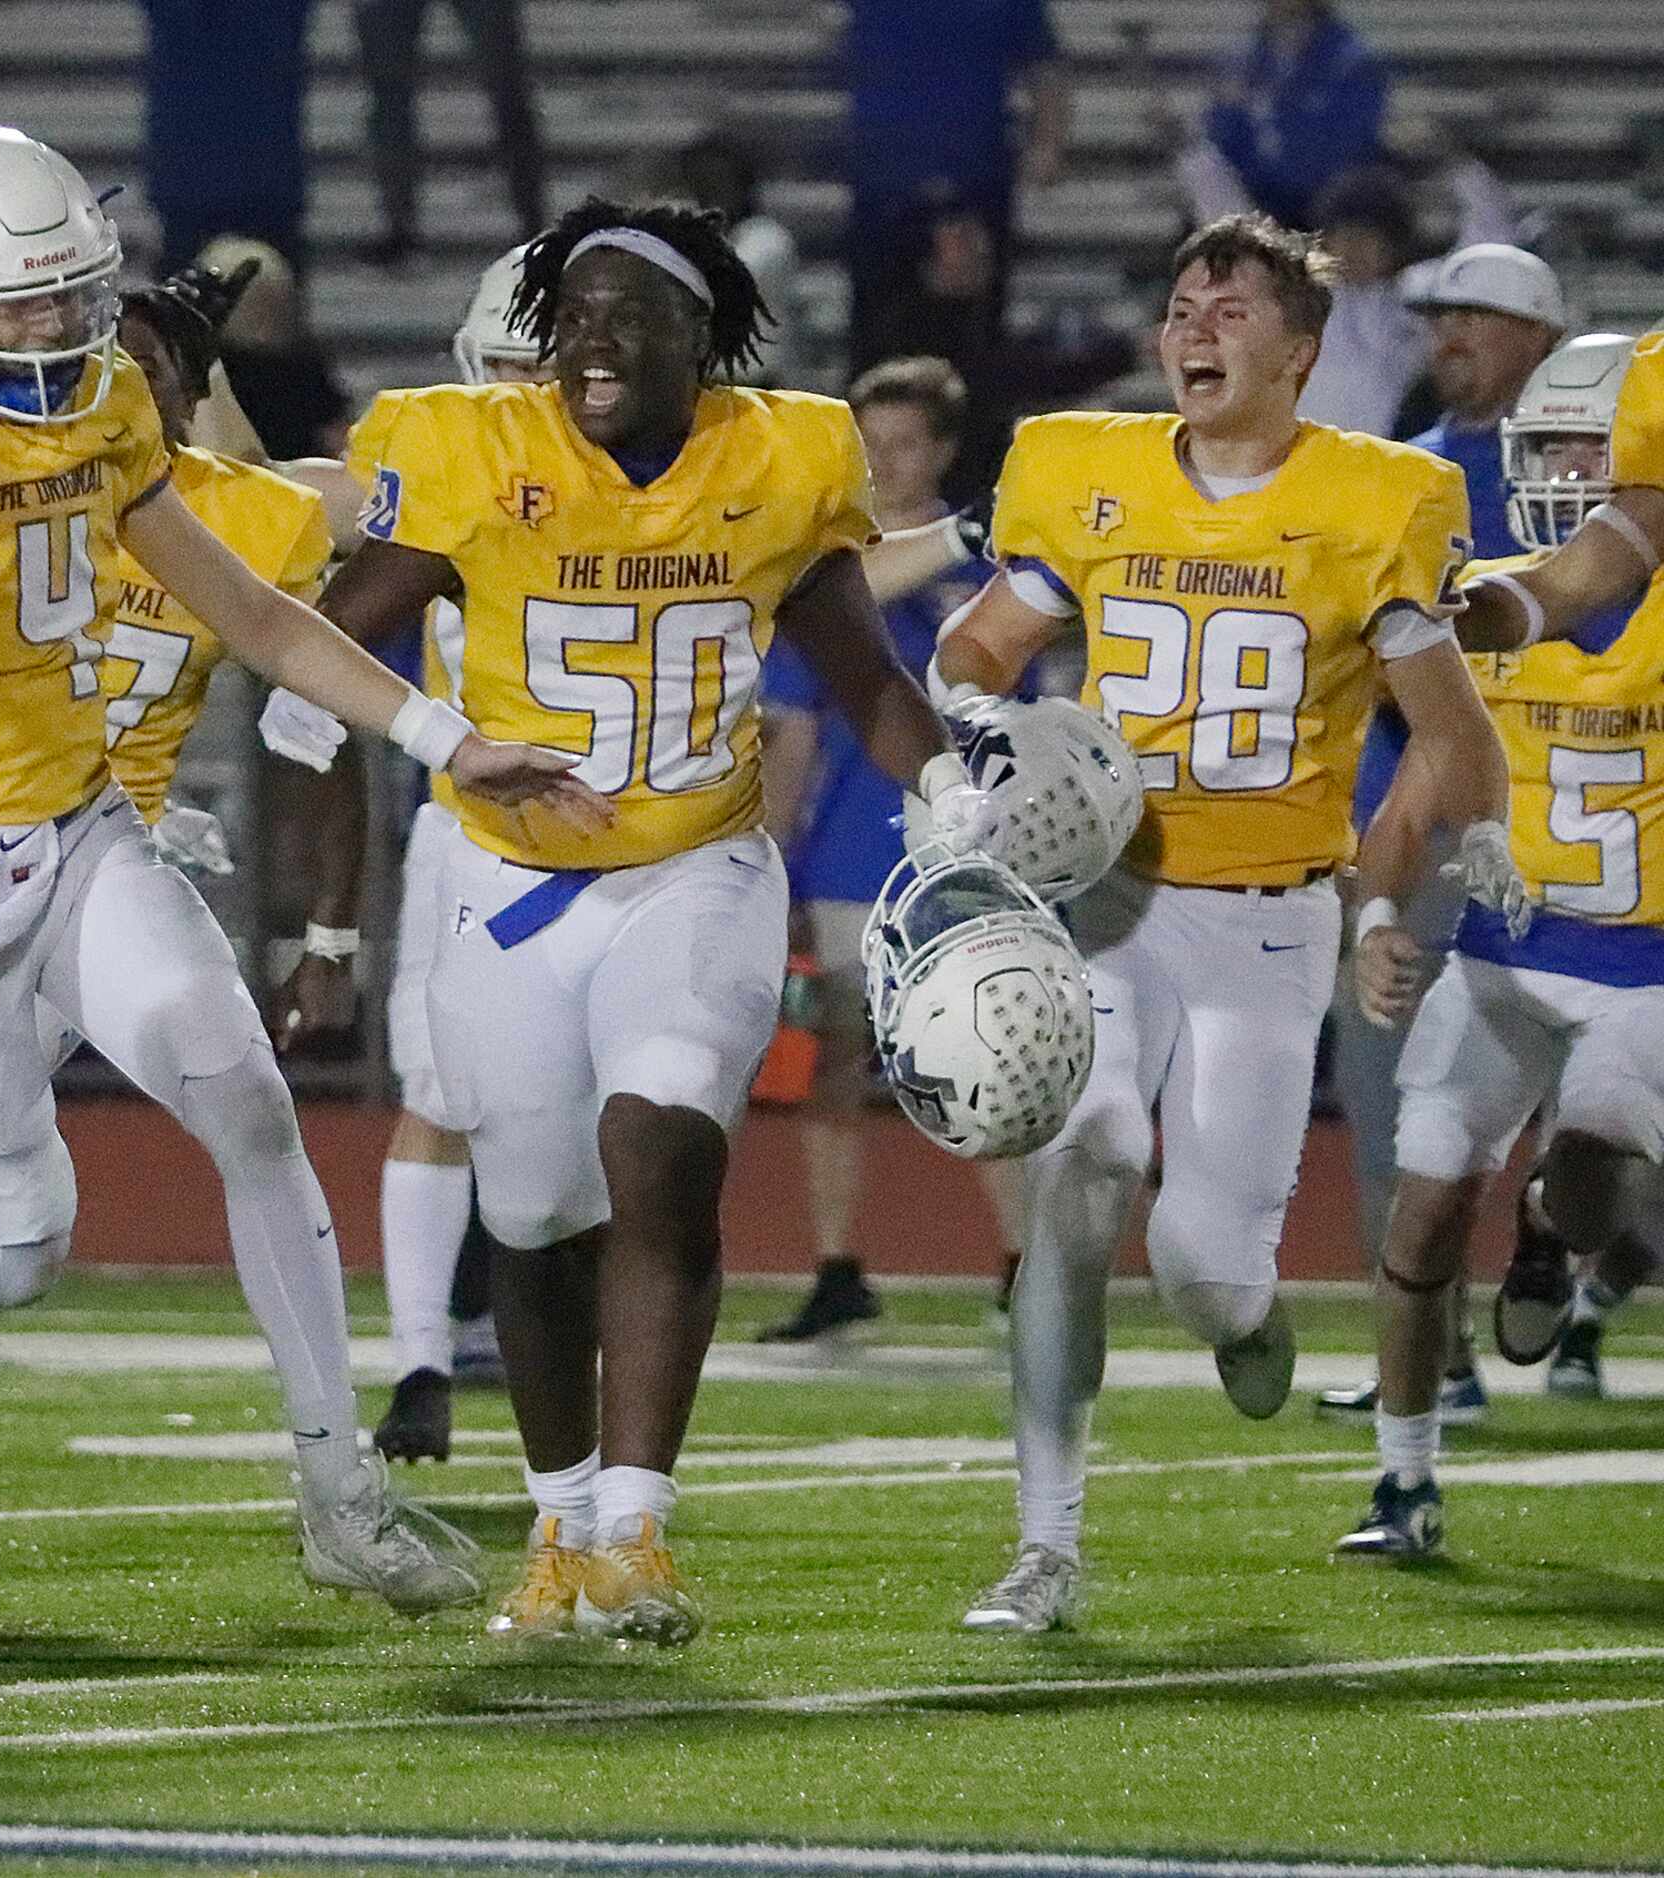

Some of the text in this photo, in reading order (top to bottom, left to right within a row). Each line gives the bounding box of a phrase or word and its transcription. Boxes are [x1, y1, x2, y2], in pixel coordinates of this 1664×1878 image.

[23, 246, 77, 270] Riddell
[519, 485, 545, 521] F
[1093, 498, 1117, 531] F
[557, 551, 734, 590] THE ORIGINAL
[1124, 554, 1288, 599] THE ORIGINAL
[16, 509, 99, 700] 4
[522, 596, 762, 795] 50
[1098, 594, 1310, 793] 28
[1543, 743, 1645, 917] 5
